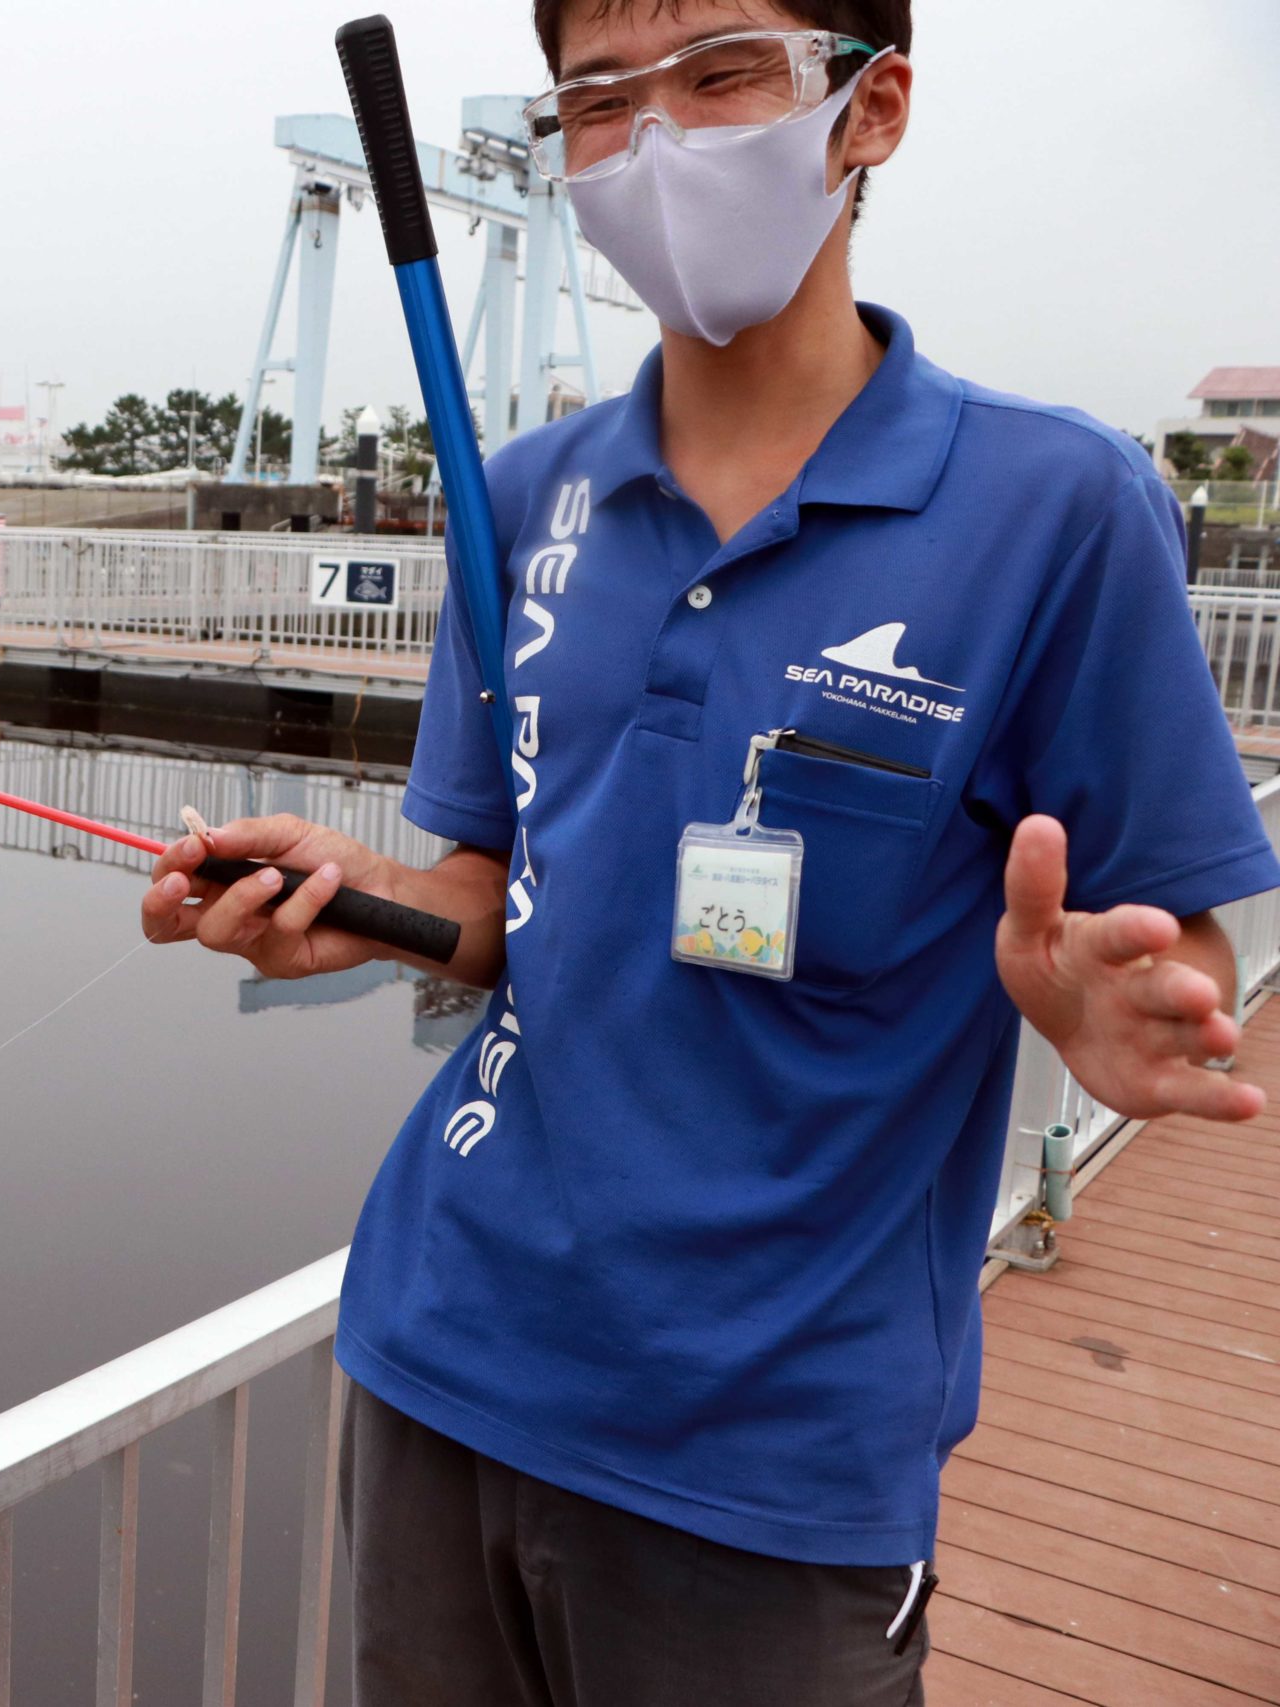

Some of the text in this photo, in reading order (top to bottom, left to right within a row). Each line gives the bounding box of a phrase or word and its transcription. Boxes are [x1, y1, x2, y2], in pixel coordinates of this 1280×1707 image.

[318, 563, 341, 598] 7
[514, 478, 592, 670] SEA
[784, 664, 965, 722] SEA PARADISE
[821, 690, 918, 725] YOKOHAMA HAKKEIJIMA
[699, 903, 746, 933] ごとう
